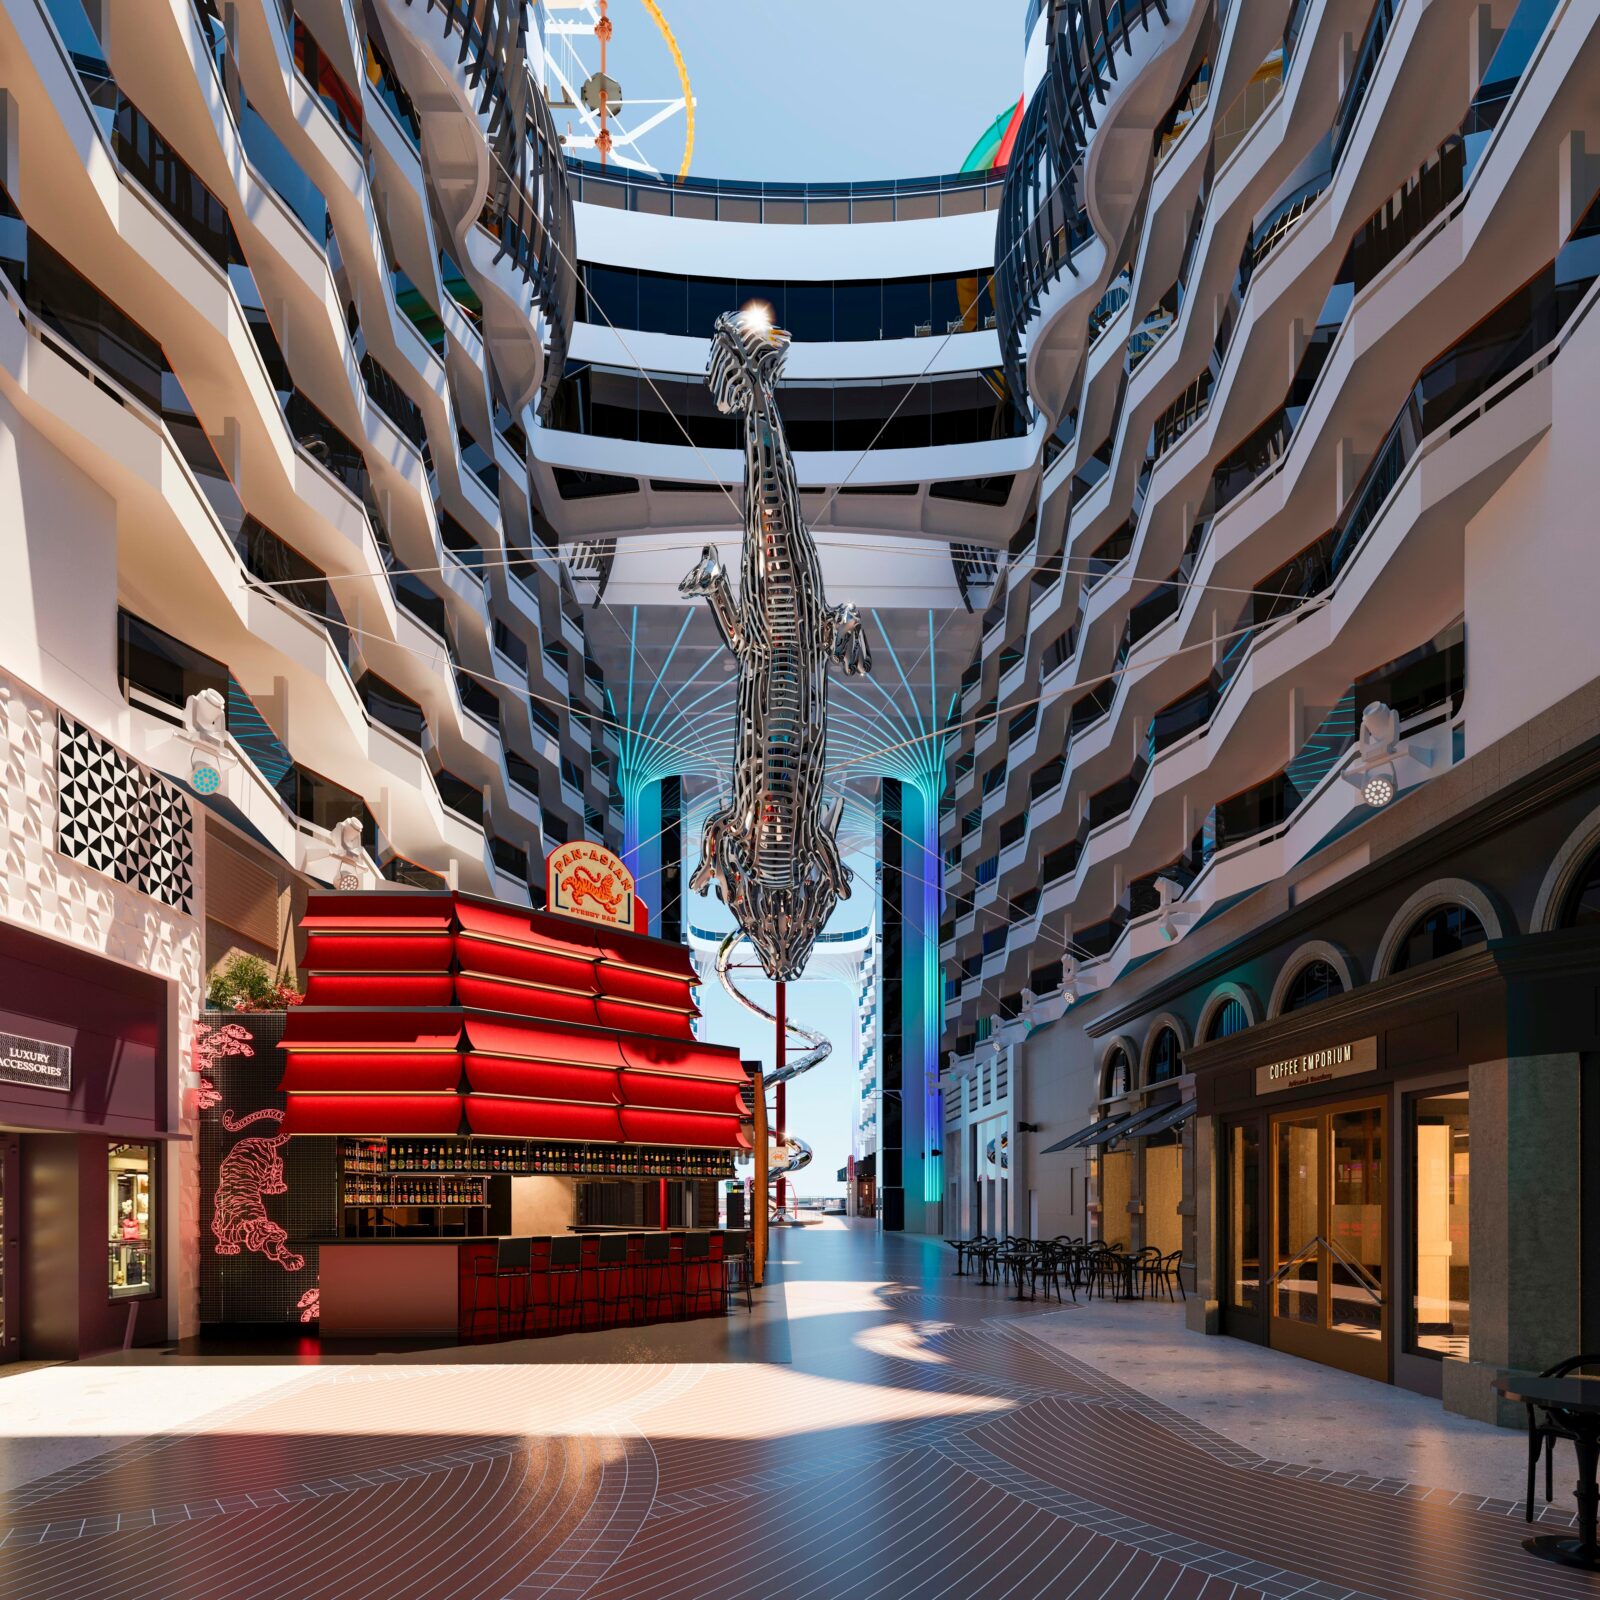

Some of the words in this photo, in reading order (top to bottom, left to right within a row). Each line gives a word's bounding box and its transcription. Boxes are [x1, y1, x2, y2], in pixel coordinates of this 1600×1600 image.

[554, 849, 632, 891] PAN-ASIAN
[9, 1048, 49, 1063] LUXURY
[1269, 1060, 1298, 1079] COFFEE
[1303, 1045, 1351, 1071] EMPORIUM
